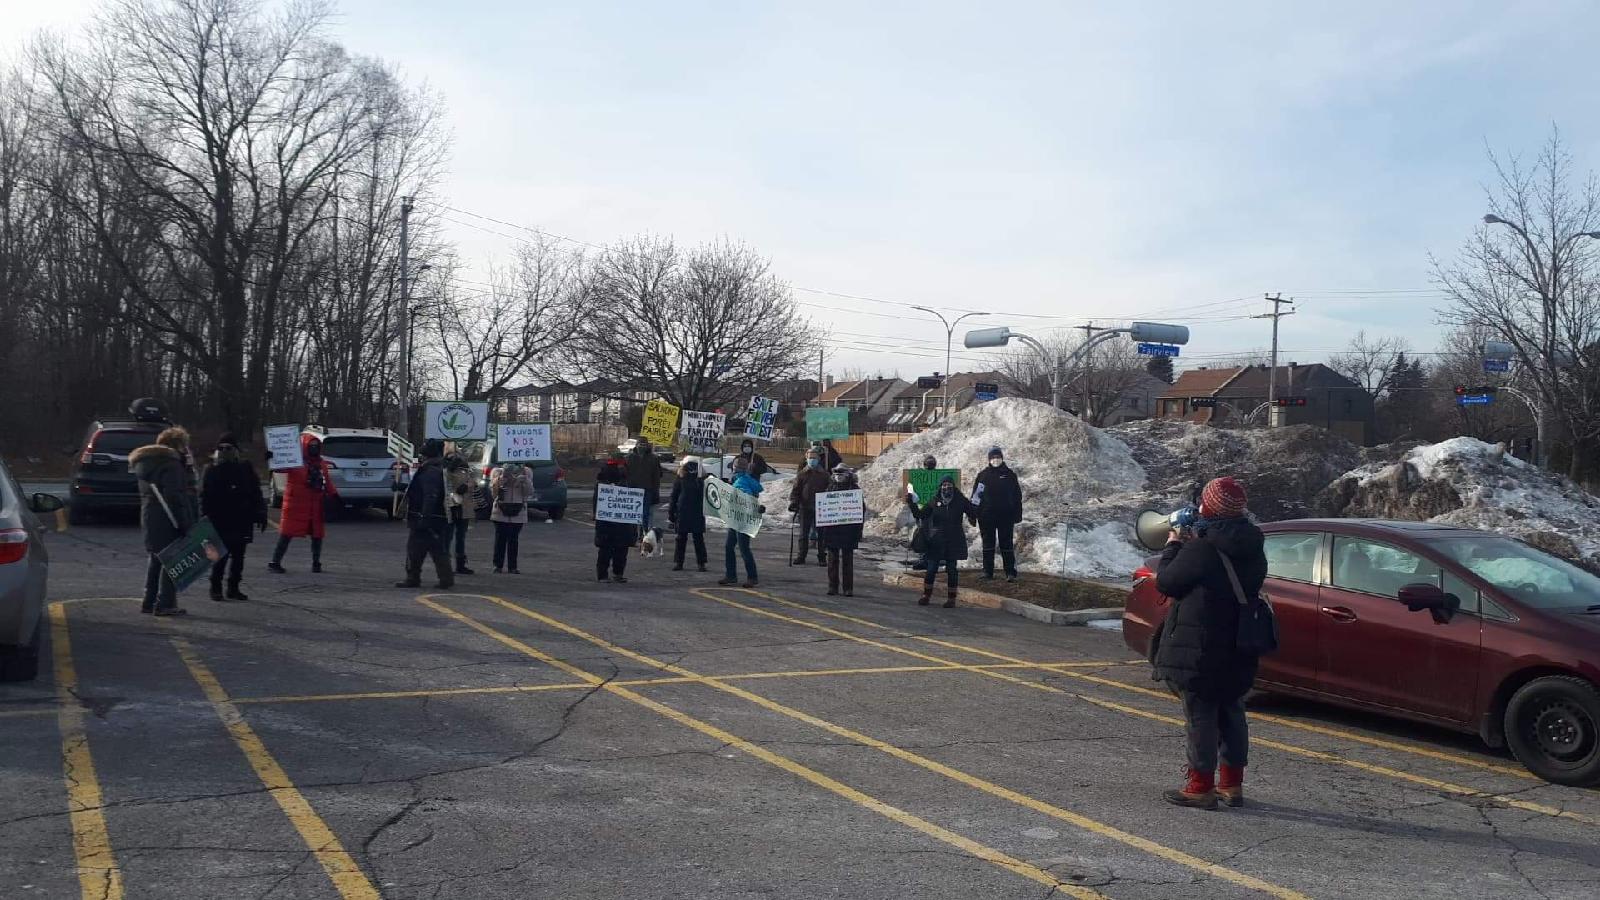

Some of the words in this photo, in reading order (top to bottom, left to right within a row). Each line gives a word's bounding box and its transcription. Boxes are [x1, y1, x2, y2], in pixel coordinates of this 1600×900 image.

[1140, 344, 1177, 356] Fairview
[752, 395, 775, 413] SAVE
[697, 420, 714, 429] SAVE
[744, 421, 773, 438] FOREST
[688, 436, 717, 448] FOREST
[607, 495, 635, 504] CLIMATE
[167, 551, 201, 580] WEBB
